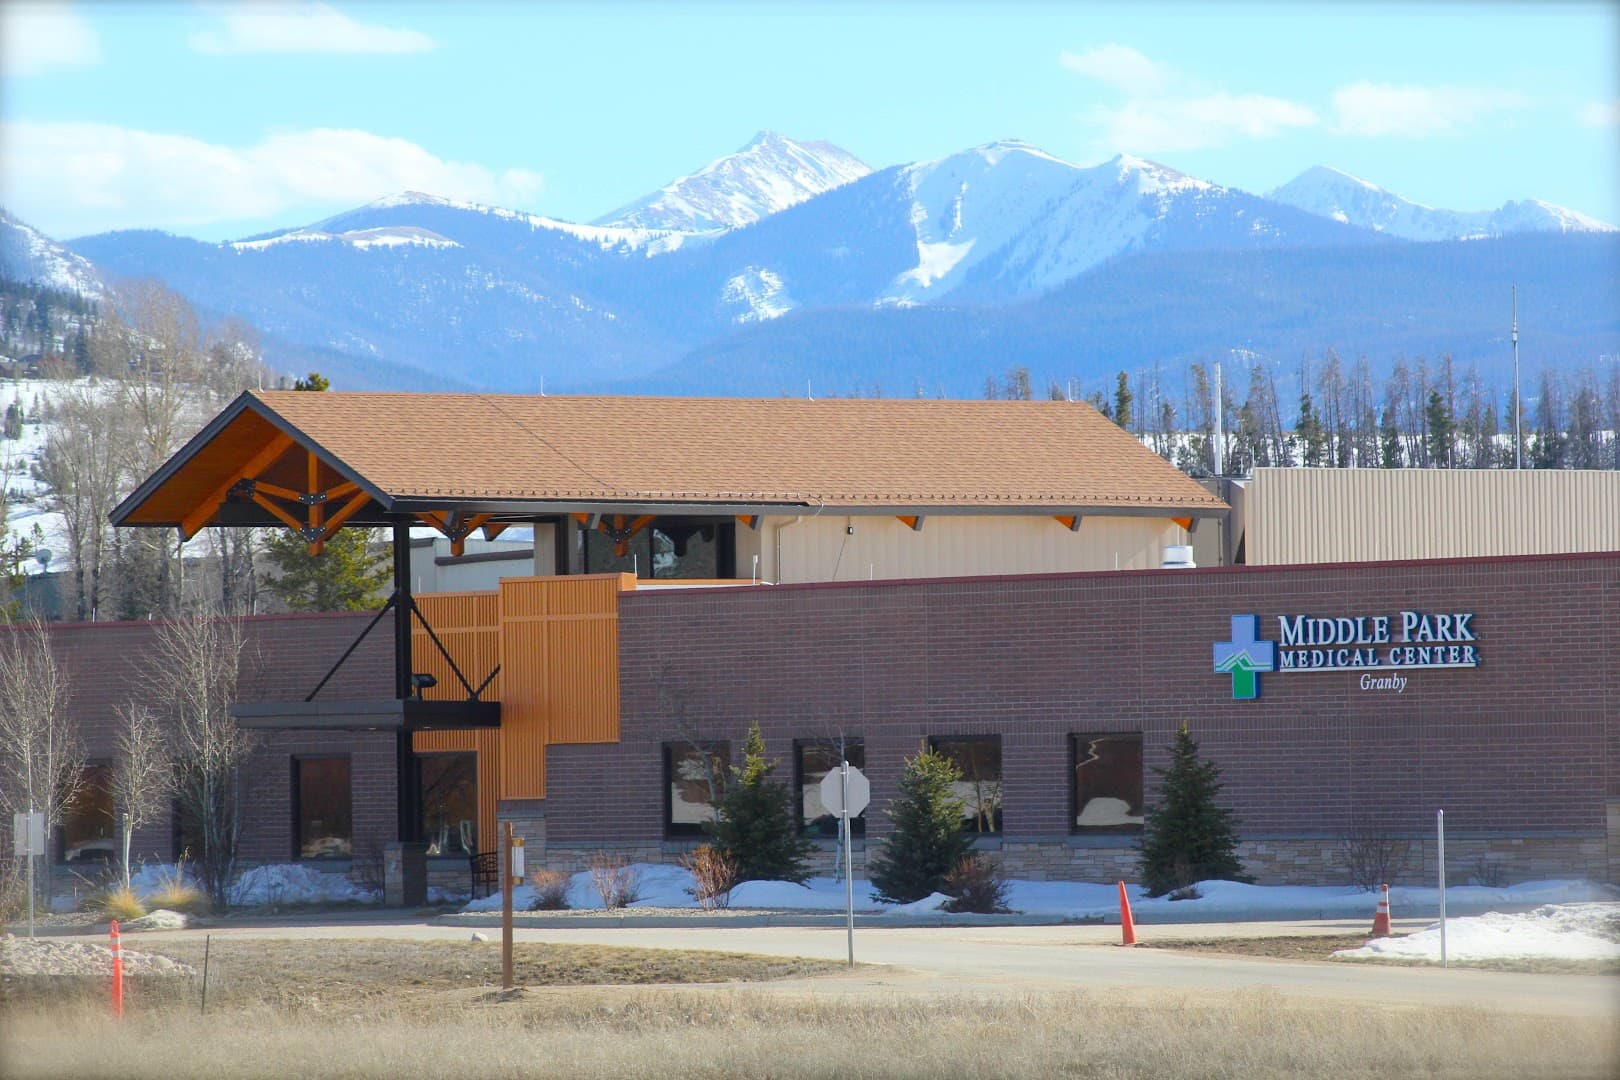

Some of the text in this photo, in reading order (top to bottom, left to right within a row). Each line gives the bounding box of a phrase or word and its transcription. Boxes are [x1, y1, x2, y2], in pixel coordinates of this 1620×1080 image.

[1278, 611, 1476, 647] MIDDLE PARK
[1280, 645, 1477, 668] MEDICAL CENTER
[1360, 673, 1408, 693] Granby
